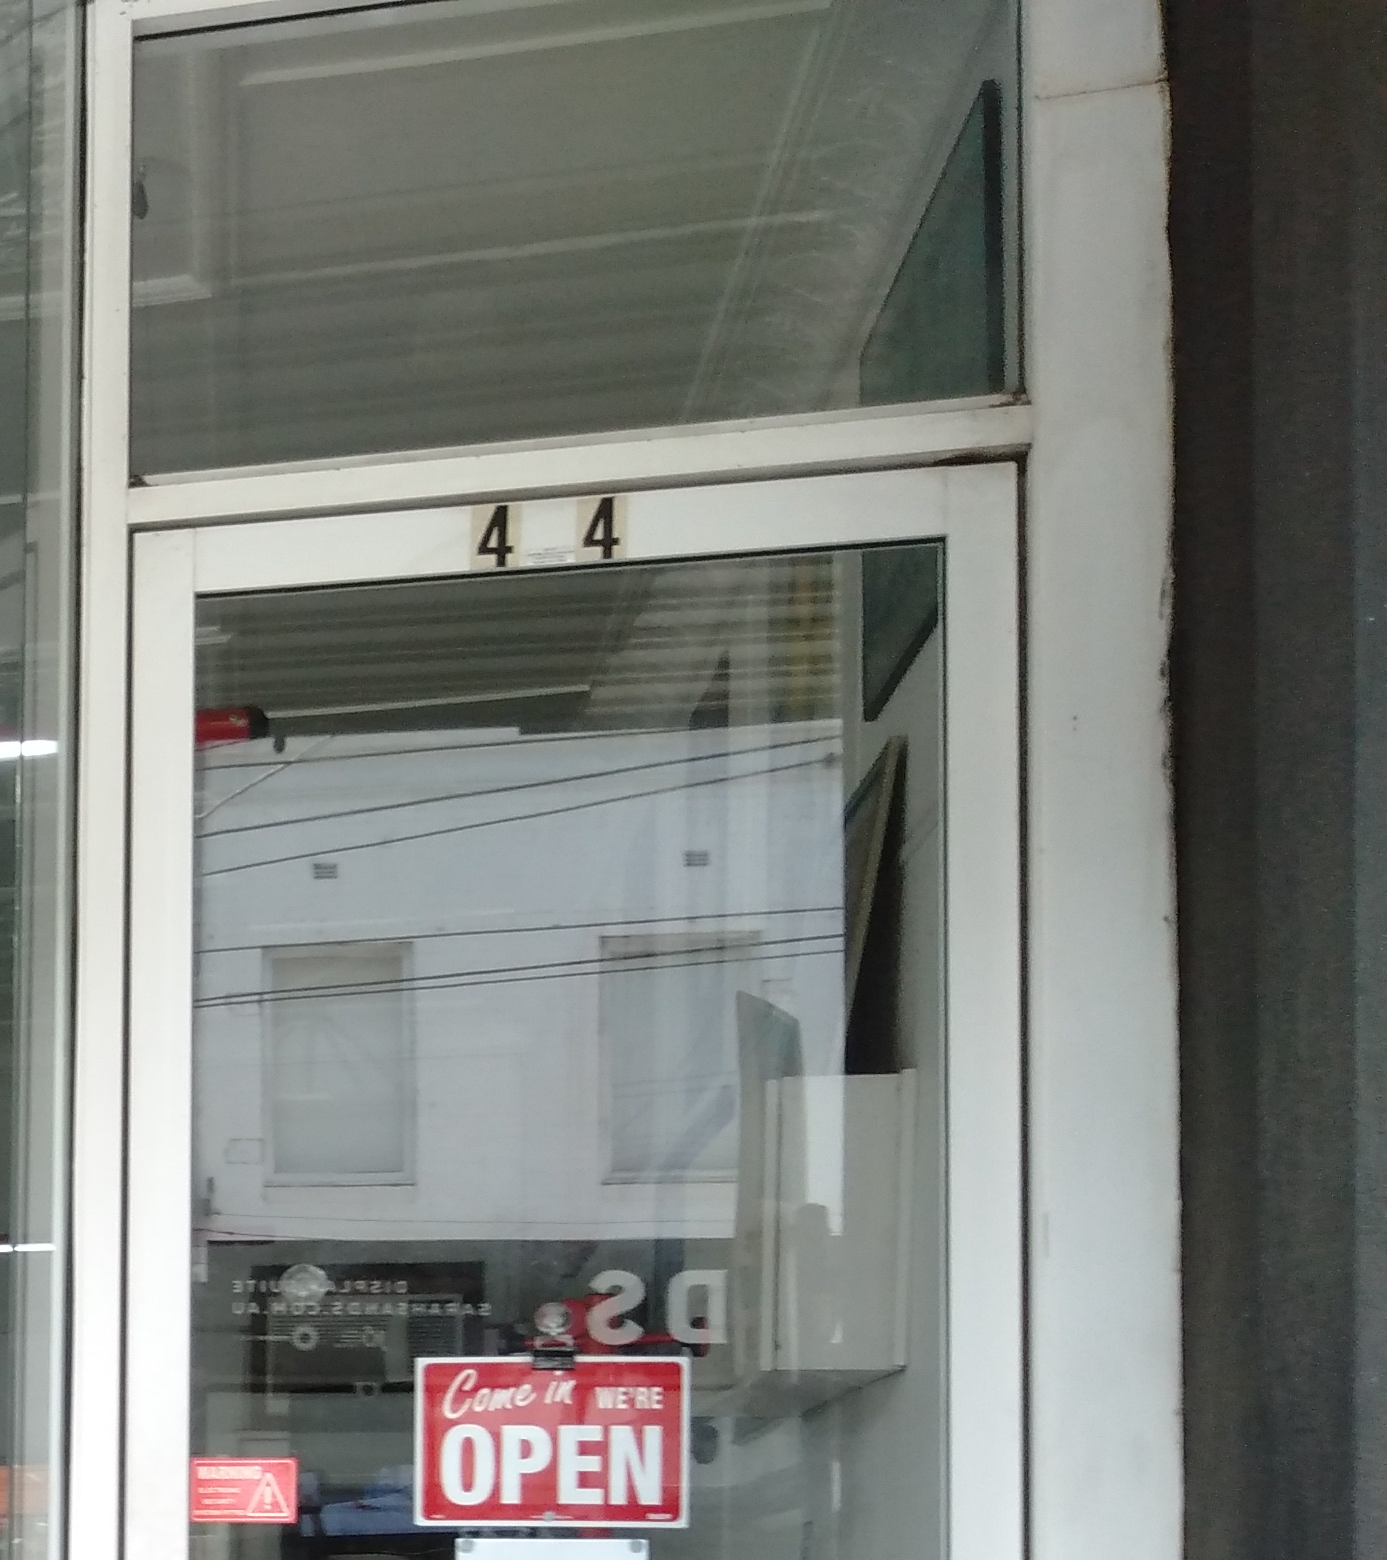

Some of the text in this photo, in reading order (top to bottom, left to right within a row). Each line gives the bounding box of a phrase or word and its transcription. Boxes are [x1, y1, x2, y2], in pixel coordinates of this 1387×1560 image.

[442, 1369, 664, 1419] Come in WE'RE
[440, 1424, 663, 1506] OPEN
